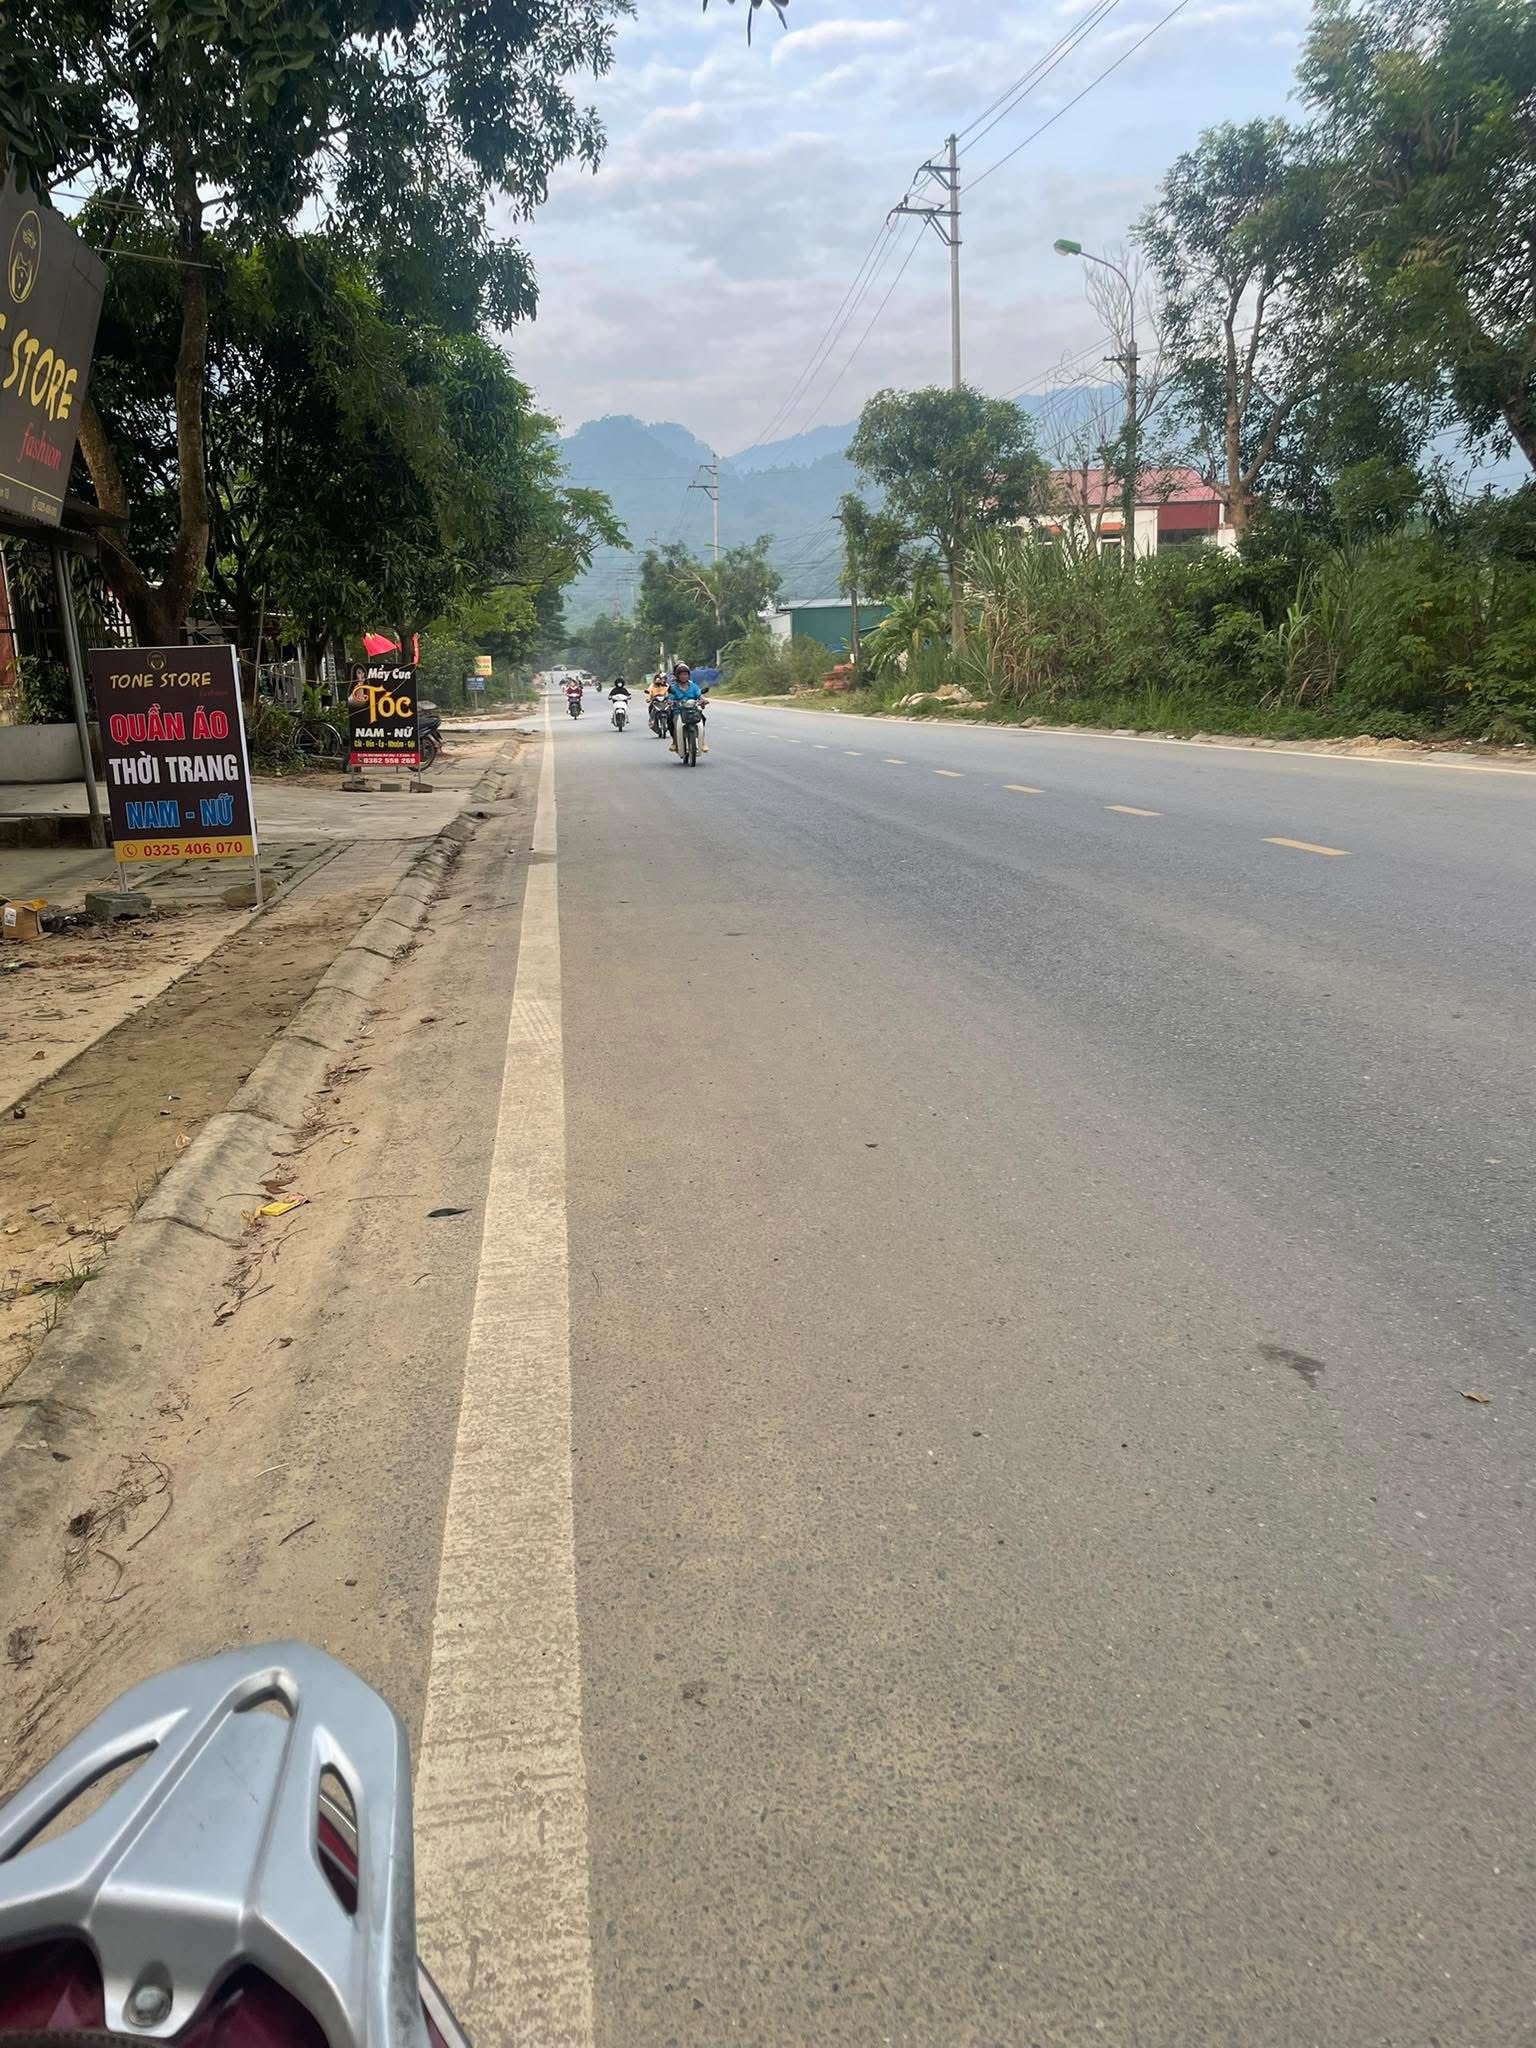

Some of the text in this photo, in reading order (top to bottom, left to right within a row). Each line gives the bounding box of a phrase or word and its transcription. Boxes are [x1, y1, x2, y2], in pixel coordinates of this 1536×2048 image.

[3, 329, 78, 421] STORE
[16, 422, 62, 472] fashion
[109, 671, 212, 689] TONE STORE
[109, 703, 229, 745] QUẦN ÁO
[355, 727, 385, 738] NAM
[394, 726, 414, 738] NỮ
[108, 751, 240, 785] THỜI TRANG
[125, 800, 181, 830] NAM
[200, 793, 234, 827] NỮ
[143, 841, 243, 857] 0325 406 070
